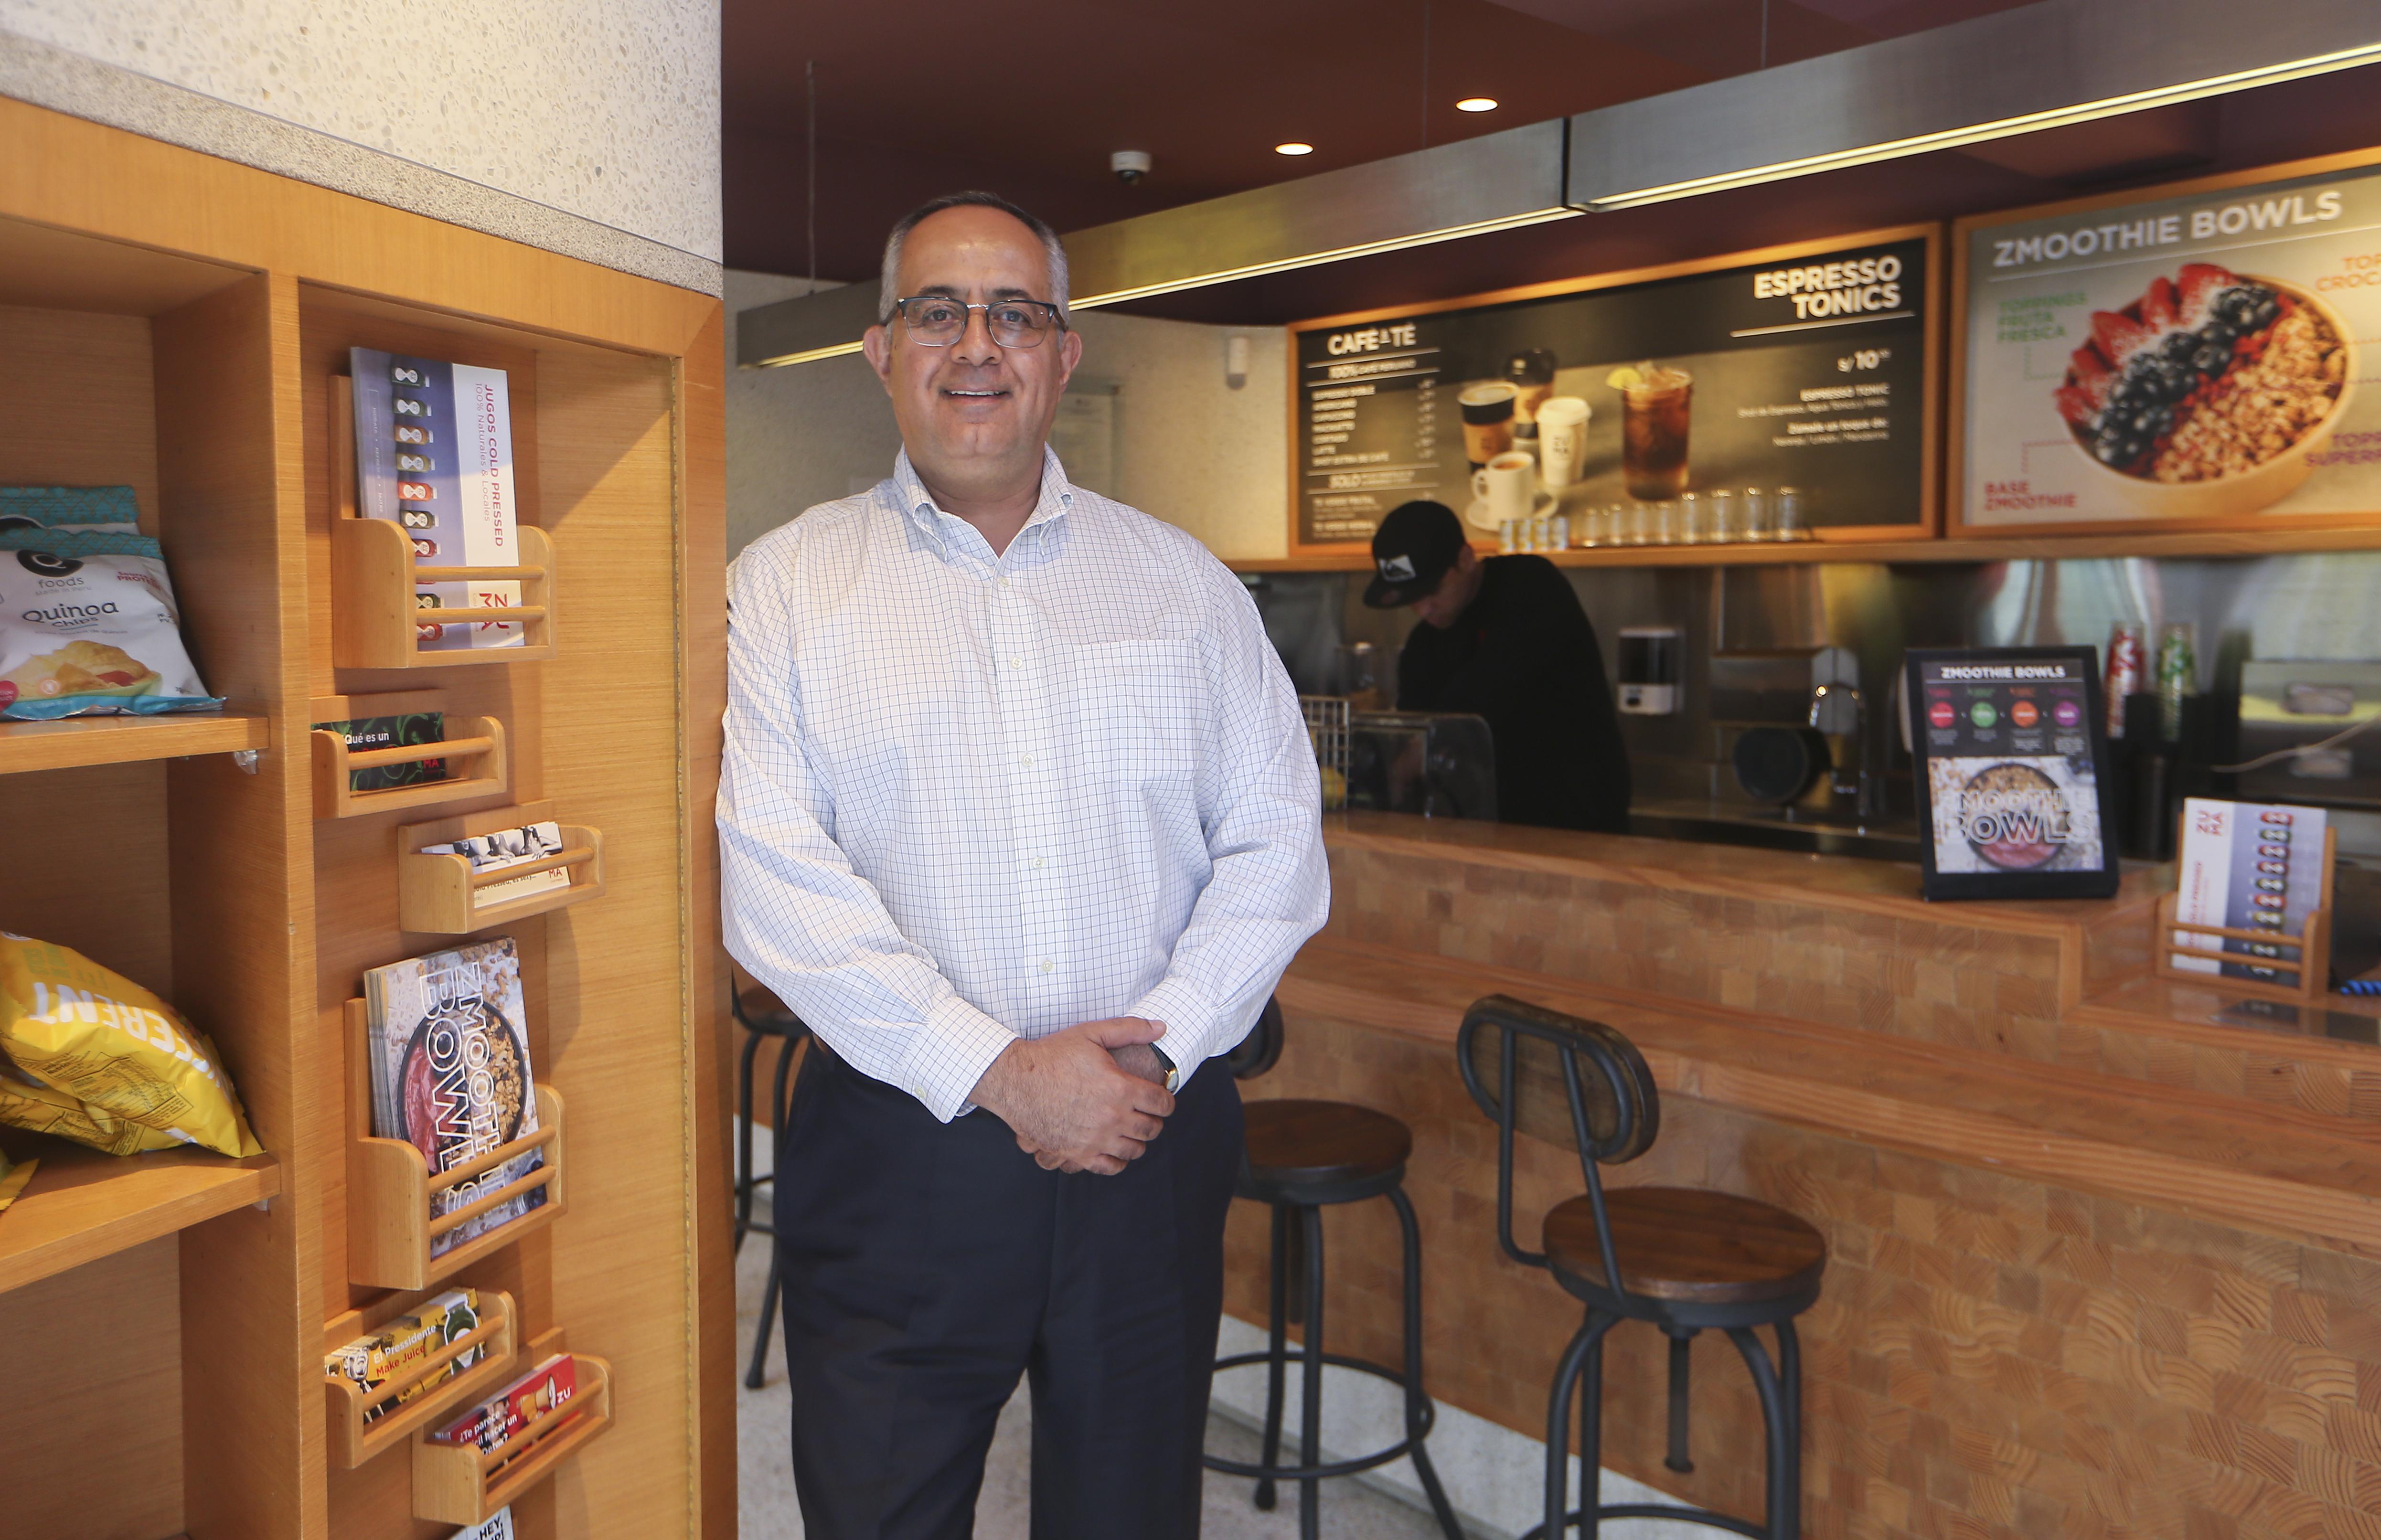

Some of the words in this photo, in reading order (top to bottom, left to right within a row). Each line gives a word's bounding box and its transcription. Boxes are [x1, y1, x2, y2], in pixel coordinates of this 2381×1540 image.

[1993, 215, 2181, 267] ZMOOTHIE
[2191, 191, 2342, 240] BOWLS
[1753, 255, 1902, 299] ESPRESSO
[1791, 282, 1902, 319] TONICS
[476, 382, 484, 411] 100%
[485, 384, 496, 433] JUGOS
[478, 414, 486, 467] Naturales
[489, 438, 499, 478] COLD
[491, 482, 503, 547] PRESSED
[38, 577, 85, 588] foods
[22, 602, 119, 623] Quinoa
[52, 617, 99, 627] Chips
[1941, 666, 2014, 680] ZMOOTHIE
[2014, 665, 2066, 679] BOWLS
[366, 734, 376, 743] es
[378, 732, 390, 741] un
[548, 868, 563, 879] MA
[374, 1350, 384, 1365] El
[385, 1325, 436, 1358] Pressidente
[375, 1359, 400, 1378] Make
[403, 1344, 426, 1363] Juice
[556, 1386, 572, 1404] ZU
[460, 1428, 473, 1443] ¿Te
[474, 1410, 500, 1435] parece
[485, 1423, 506, 1442] hacer
[507, 1413, 518, 1426] un
